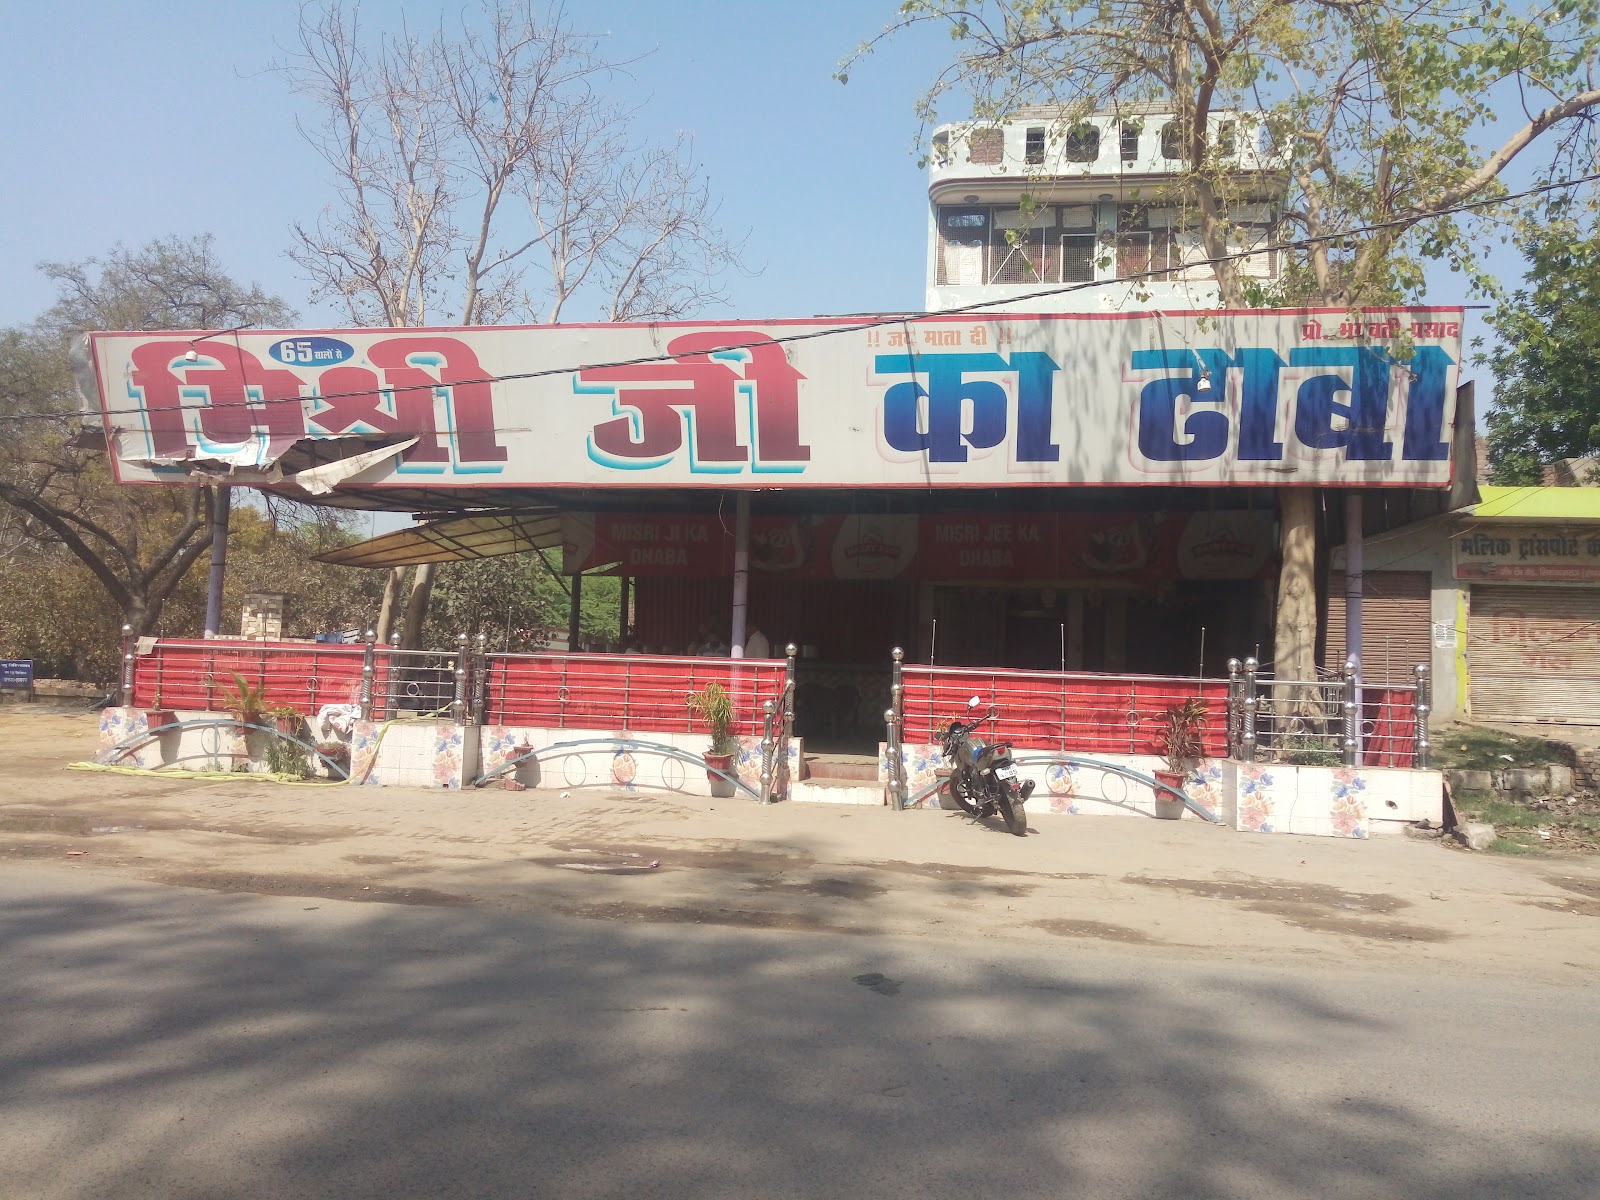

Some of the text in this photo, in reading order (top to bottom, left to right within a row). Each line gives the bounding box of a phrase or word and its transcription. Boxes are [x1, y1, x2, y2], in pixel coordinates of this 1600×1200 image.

[924, 330, 962, 346] माता
[969, 325, 988, 346] दी
[1411, 321, 1459, 339] प्रसाद
[280, 341, 343, 363] 65 सालों से
[580, 331, 809, 463] जी
[874, 350, 1060, 463] का
[1131, 346, 1457, 462] ढाबा
[611, 523, 709, 544] MISRI JI KA
[935, 523, 1040, 544] MISRI JEE KA
[631, 547, 689, 568] DHABA
[959, 549, 1015, 569] DHABA
